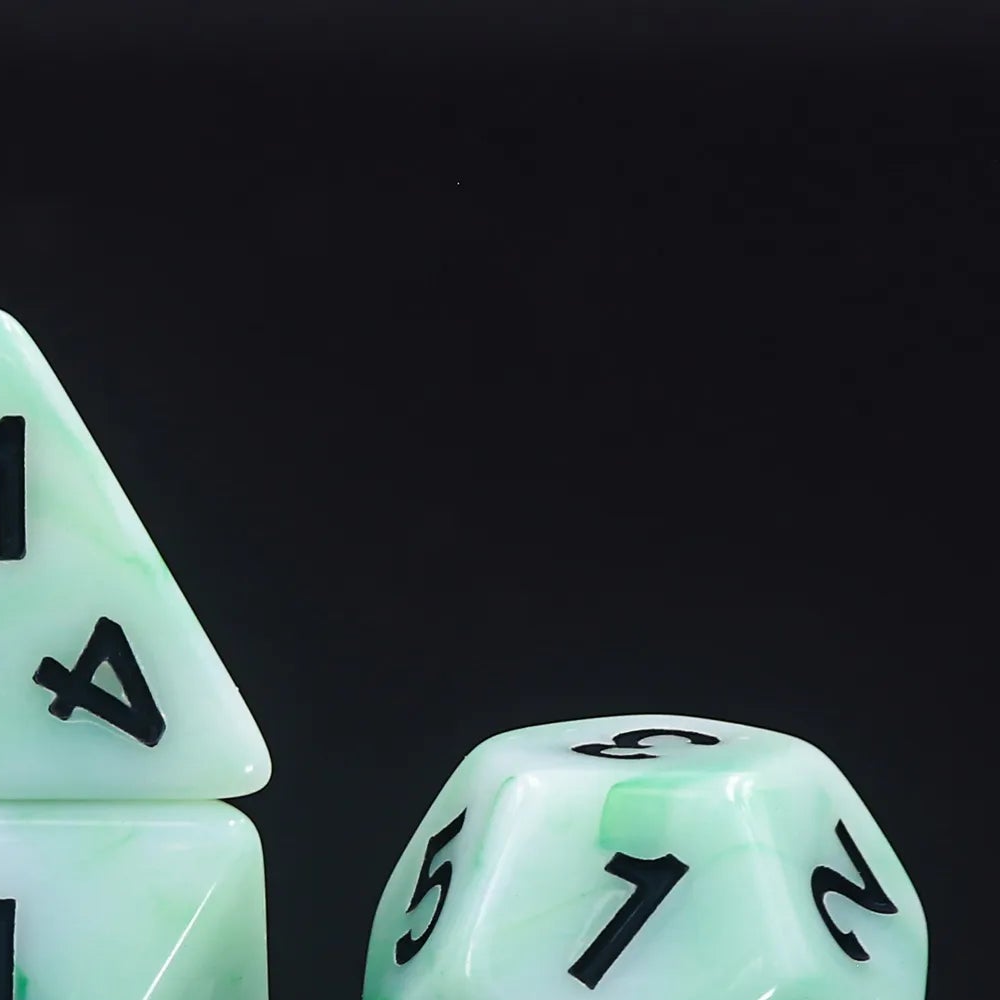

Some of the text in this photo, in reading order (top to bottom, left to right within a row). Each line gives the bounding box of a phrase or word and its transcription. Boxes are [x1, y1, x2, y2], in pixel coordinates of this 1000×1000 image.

[32, 617, 166, 747] 4
[572, 729, 720, 760] 3
[396, 808, 467, 965] 5
[568, 852, 689, 990] 1
[811, 819, 898, 962] 2
